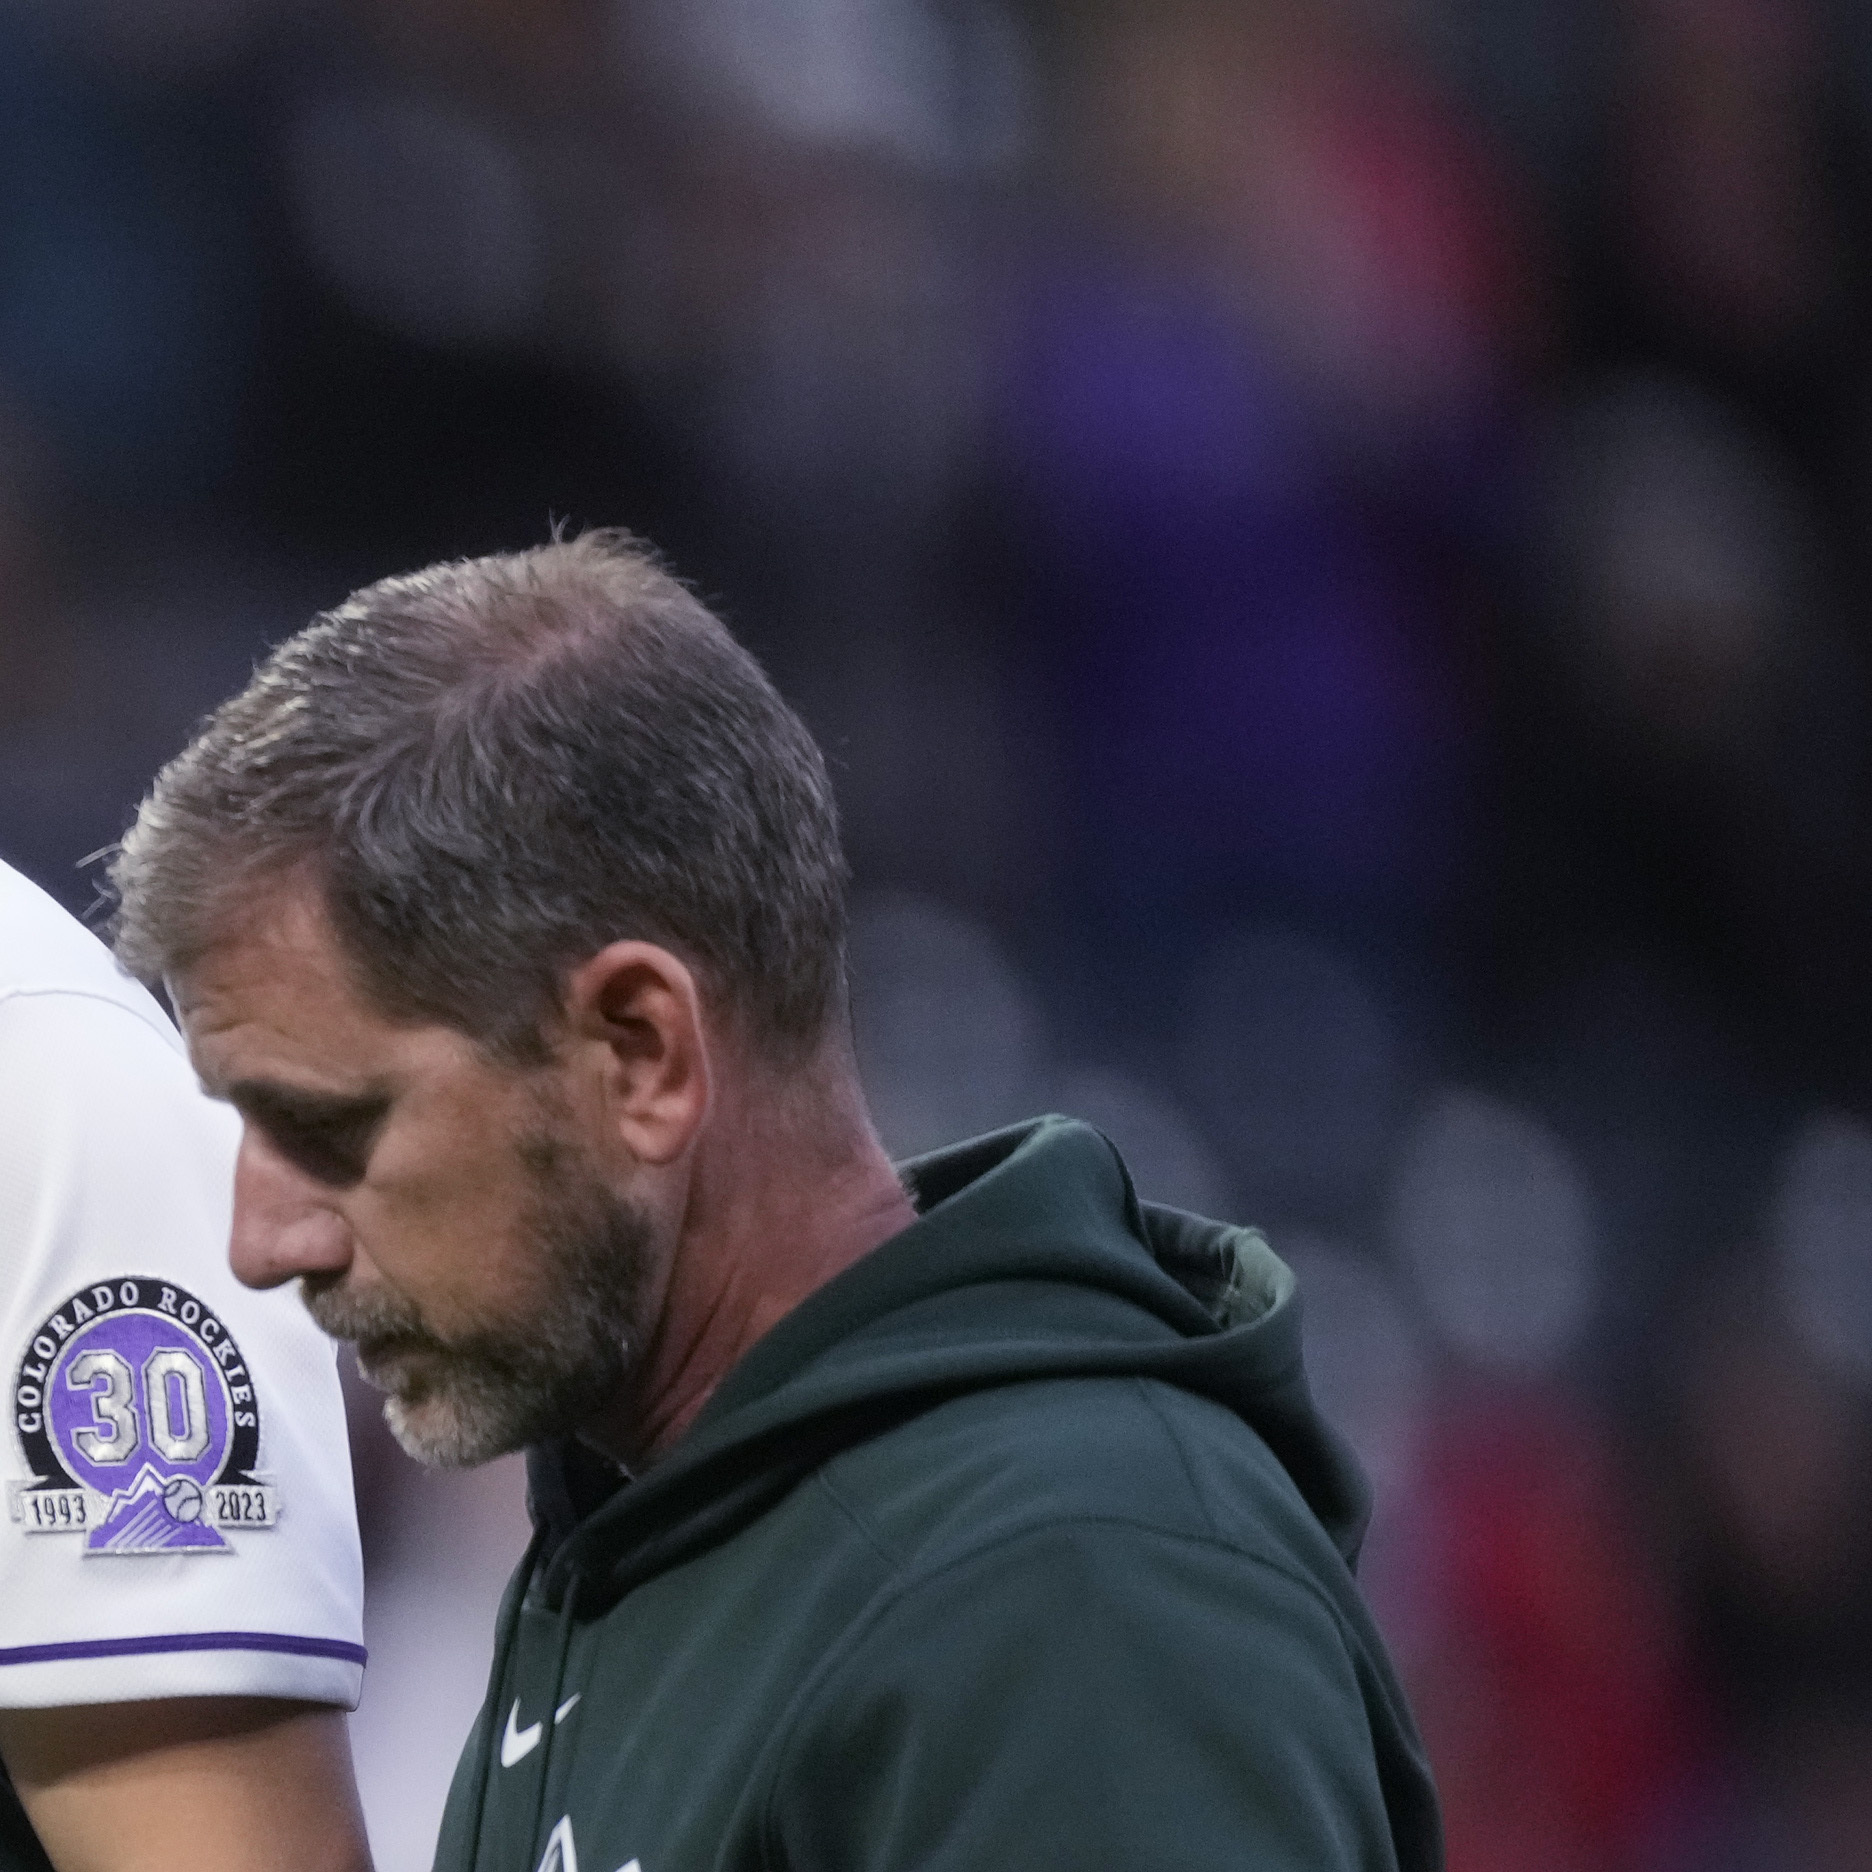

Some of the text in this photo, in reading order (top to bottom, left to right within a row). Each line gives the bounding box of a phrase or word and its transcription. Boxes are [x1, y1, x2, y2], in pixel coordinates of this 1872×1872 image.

[17, 1280, 256, 1434] COLORADO ROCKIES
[64, 1345, 213, 1468] 30
[30, 1494, 88, 1528] 1993
[215, 1491, 268, 1522] 2023
